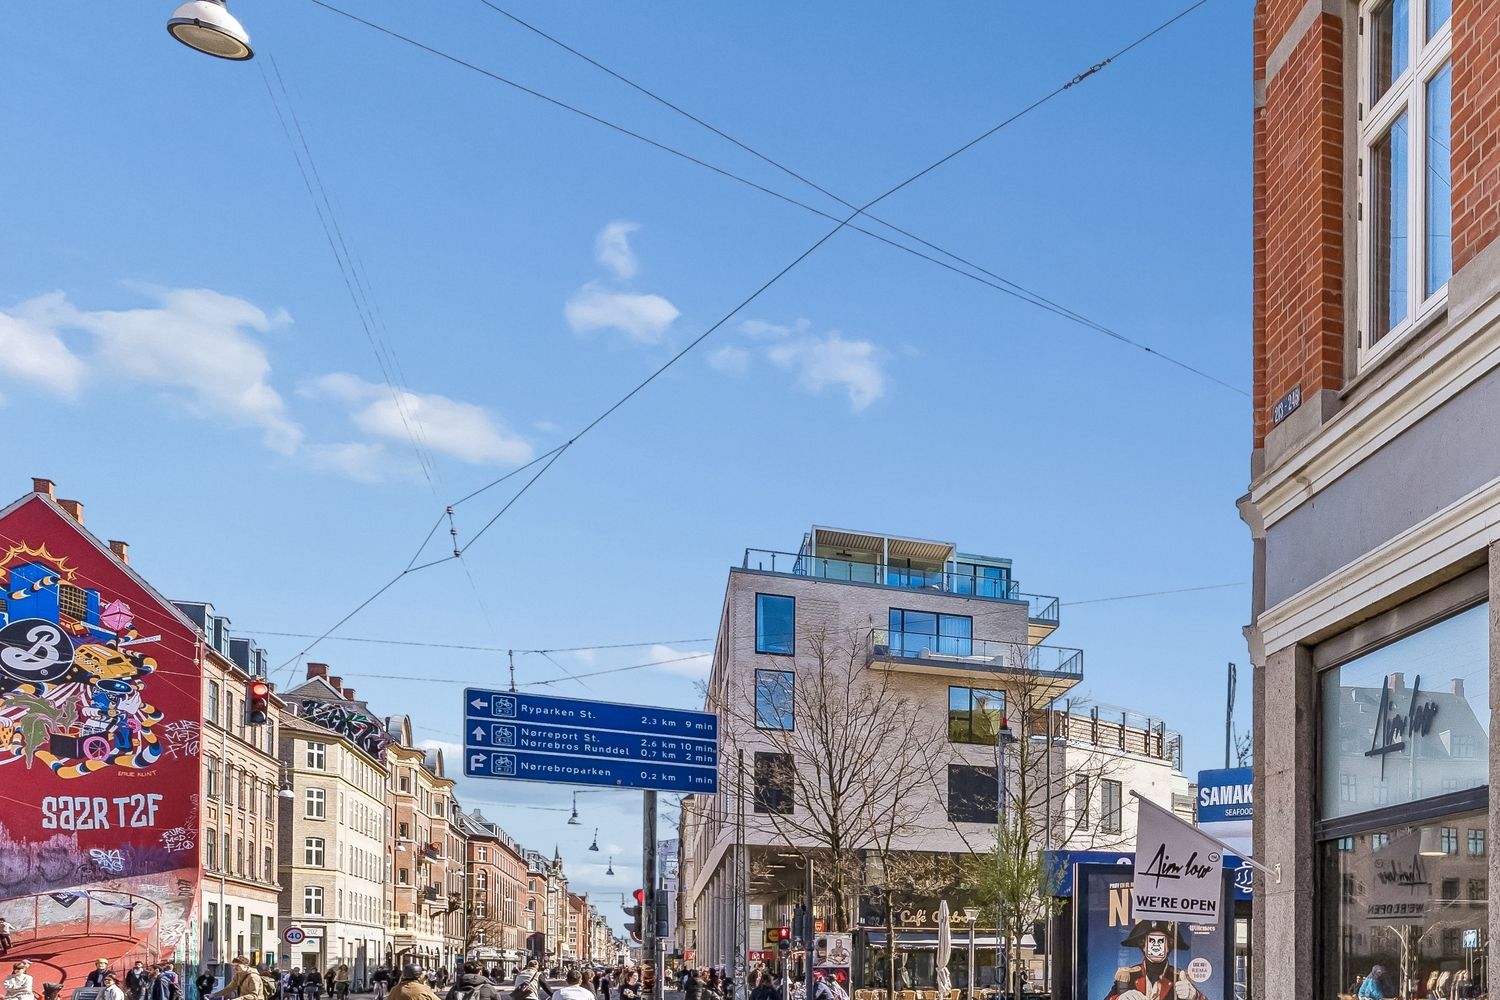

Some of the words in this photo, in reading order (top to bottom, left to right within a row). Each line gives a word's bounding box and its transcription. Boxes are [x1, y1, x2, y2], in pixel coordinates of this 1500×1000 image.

[521, 704, 574, 717] Ryparken
[580, 711, 596, 719] St.
[641, 716, 657, 725] 2.3
[662, 719, 676, 727] km
[685, 721, 692, 729] 9
[695, 723, 713, 731] min
[521, 728, 578, 740] Nørreport
[584, 734, 600, 742] St.
[641, 739, 657, 748] 2.6
[662, 741, 676, 749] km
[681, 742, 692, 750] 10
[695, 745, 713, 753] min
[521, 739, 579, 751] Nørrebros
[584, 744, 630, 755] Runddel
[640, 749, 657, 758] 0.7
[662, 751, 676, 759] km
[686, 753, 692, 761] 2
[695, 755, 713, 763] min
[521, 762, 611, 776] Nørrebroparken
[640, 771, 657, 780] 0.2
[662, 773, 676, 781] km
[688, 775, 692, 783] 1
[695, 776, 713, 784] min
[1138, 843, 1183, 889] Aim
[1136, 895, 1178, 909] WE'RE
[1181, 898, 1216, 912] OPEN
[900, 909, 927, 927] Café
[287, 932, 302, 940] 40
